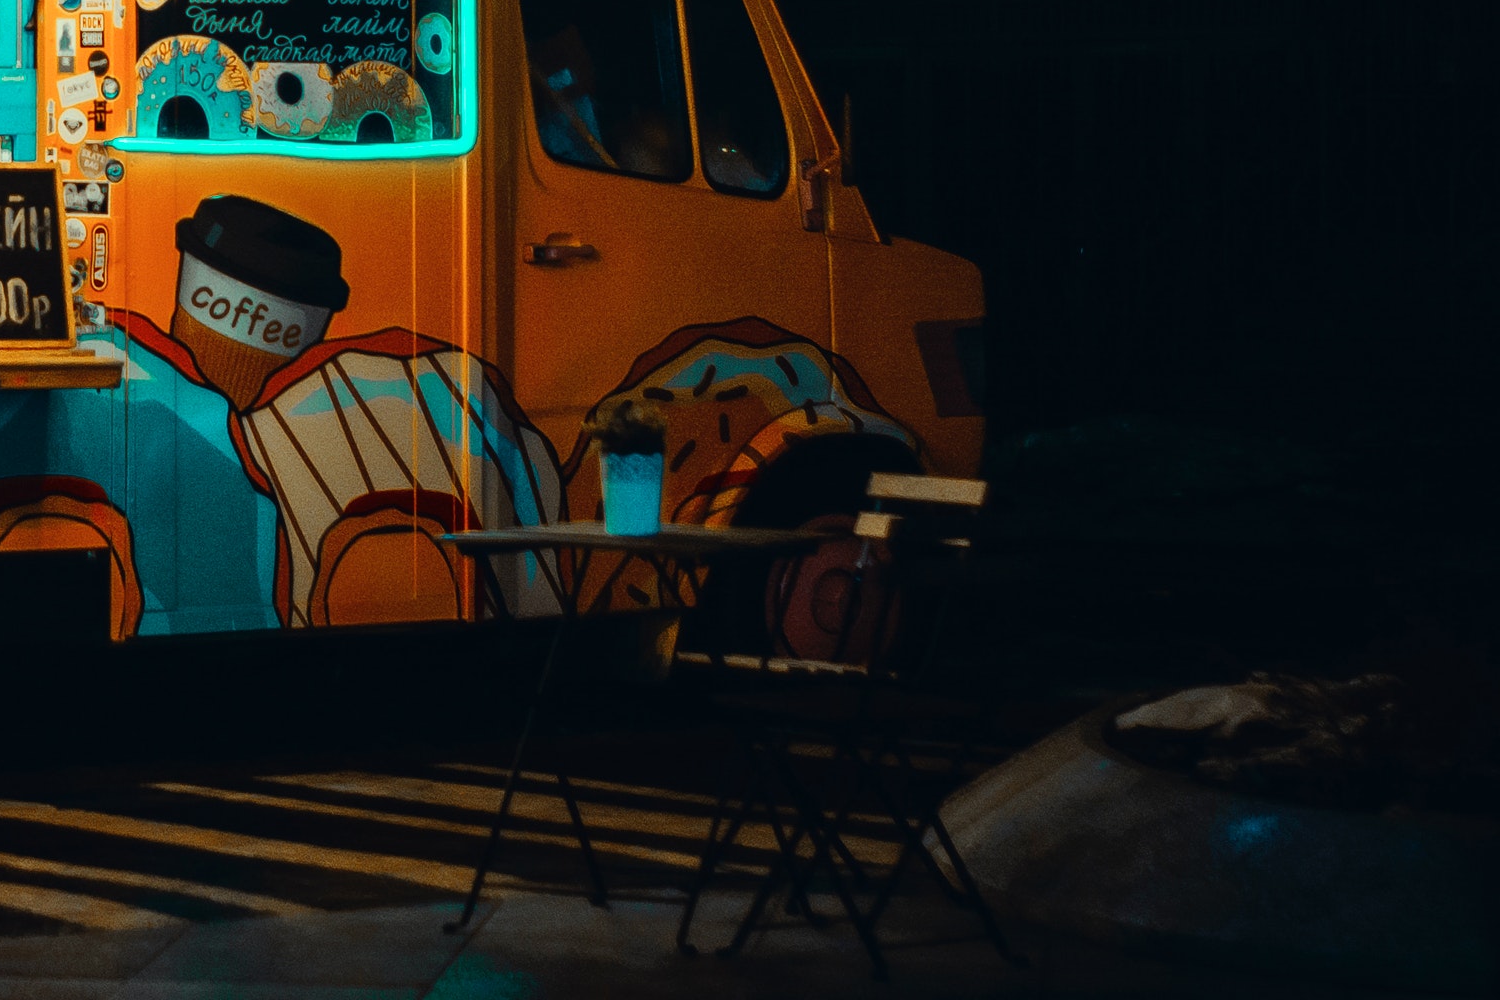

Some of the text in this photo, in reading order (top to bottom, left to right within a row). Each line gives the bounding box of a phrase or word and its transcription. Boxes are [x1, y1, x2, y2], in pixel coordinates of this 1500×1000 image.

[82, 16, 102, 29] ROCK
[185, 6, 411, 43] дыня лайм
[242, 35, 413, 69] сладкая мята
[93, 233, 106, 282] ABUS
[190, 286, 303, 349] coffee
